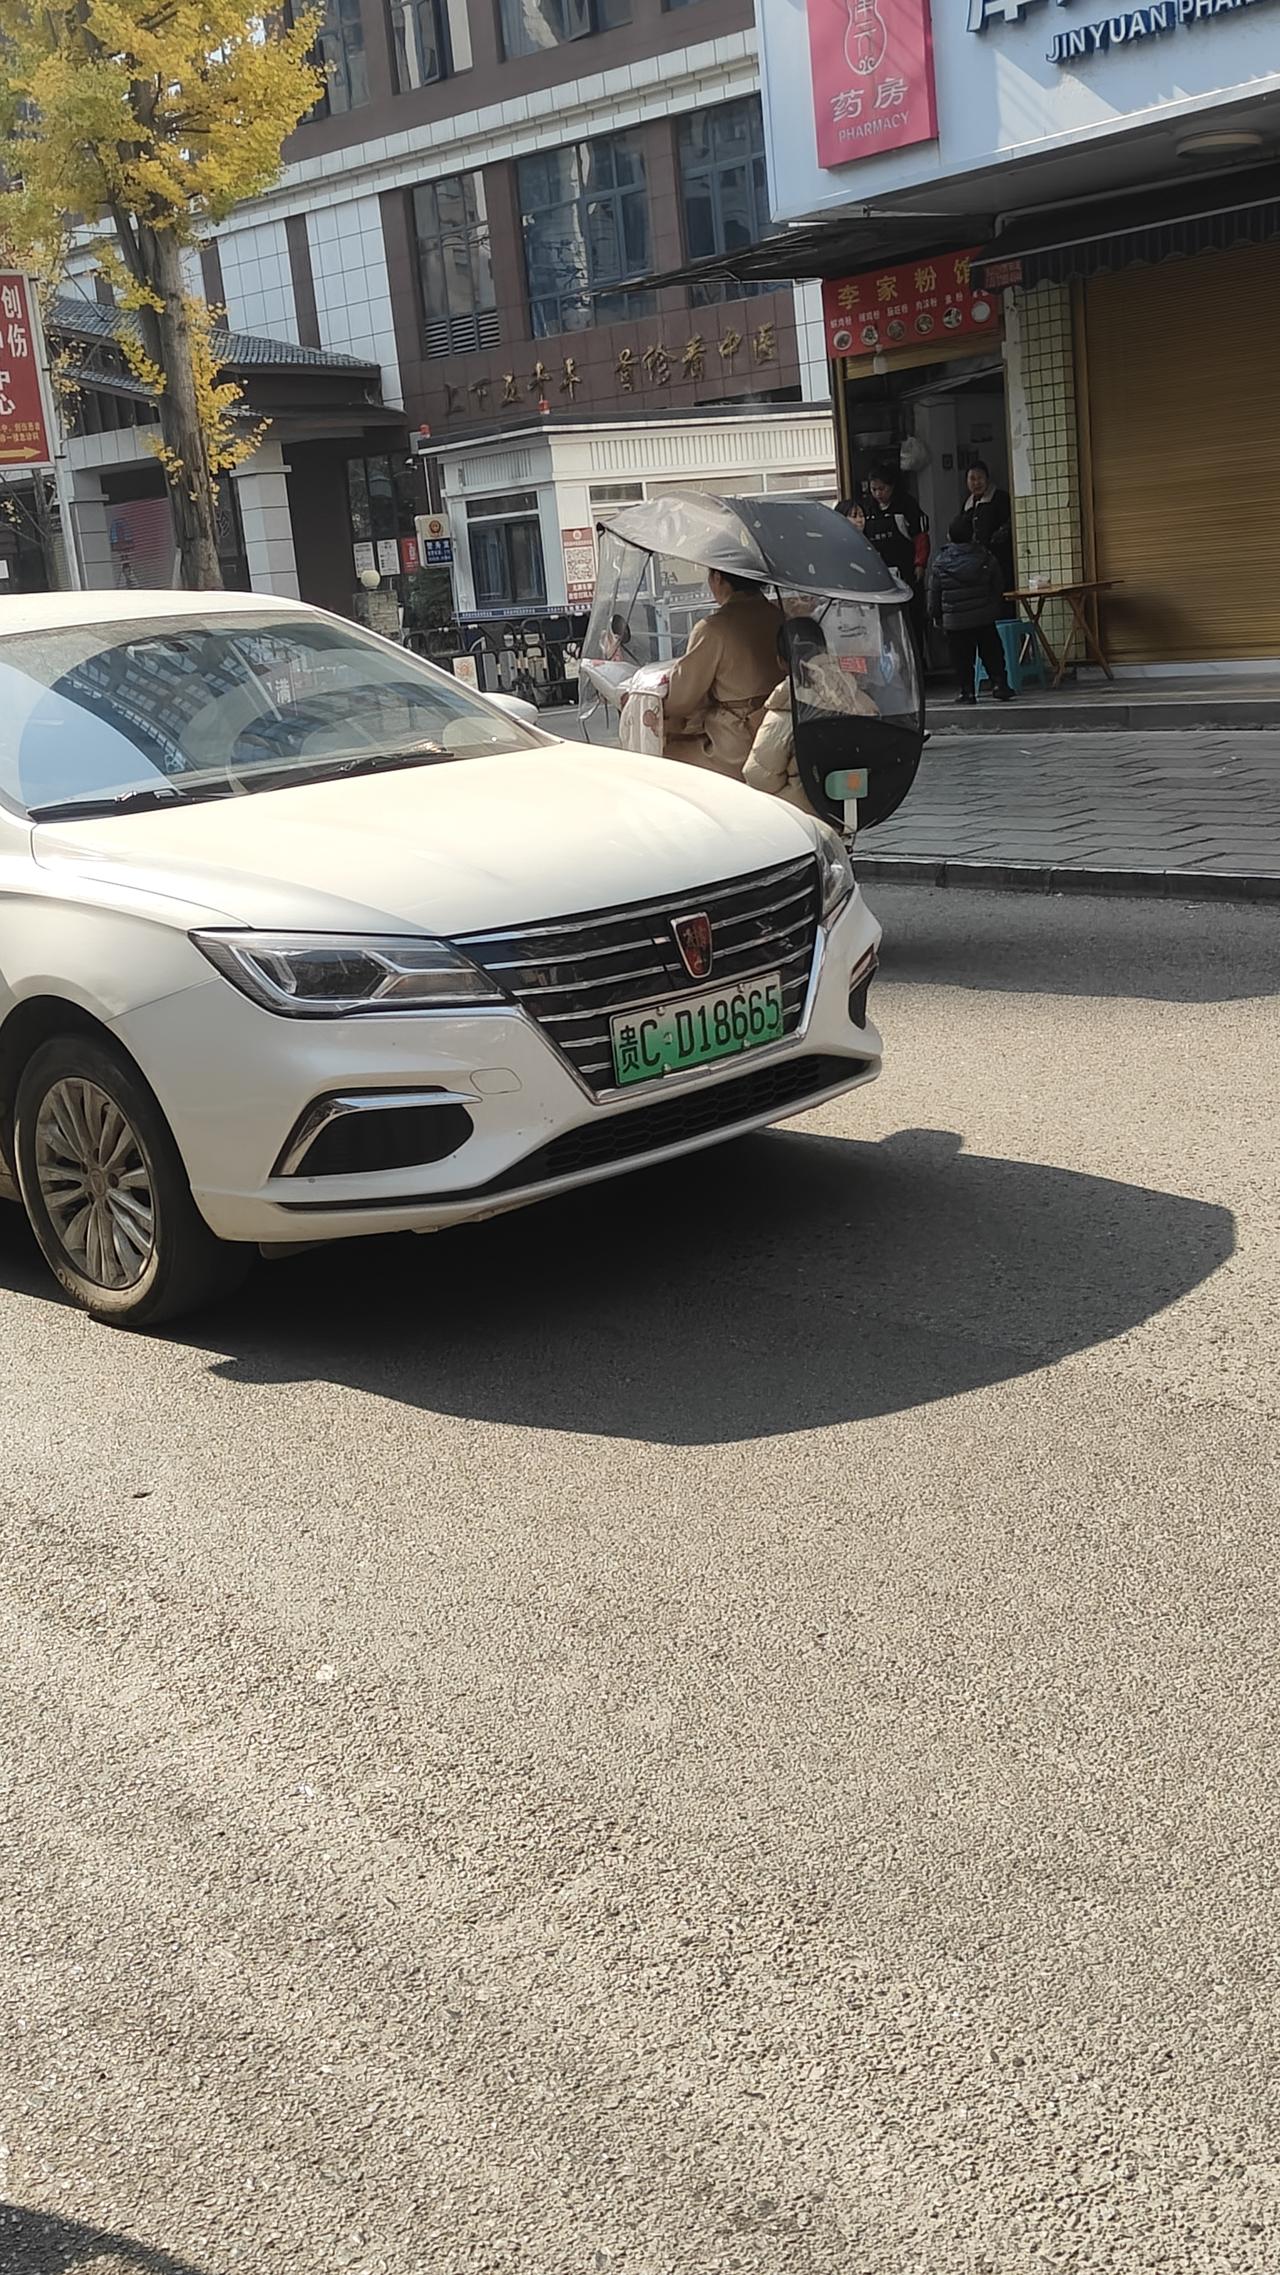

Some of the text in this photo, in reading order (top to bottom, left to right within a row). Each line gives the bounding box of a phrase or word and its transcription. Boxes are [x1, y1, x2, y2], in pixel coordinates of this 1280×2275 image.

[1045, 3, 1168, 63] JINYUAN
[830, 77, 909, 123] 药房
[838, 110, 910, 143] PHARMACY
[1, 285, 28, 358] 创伤
